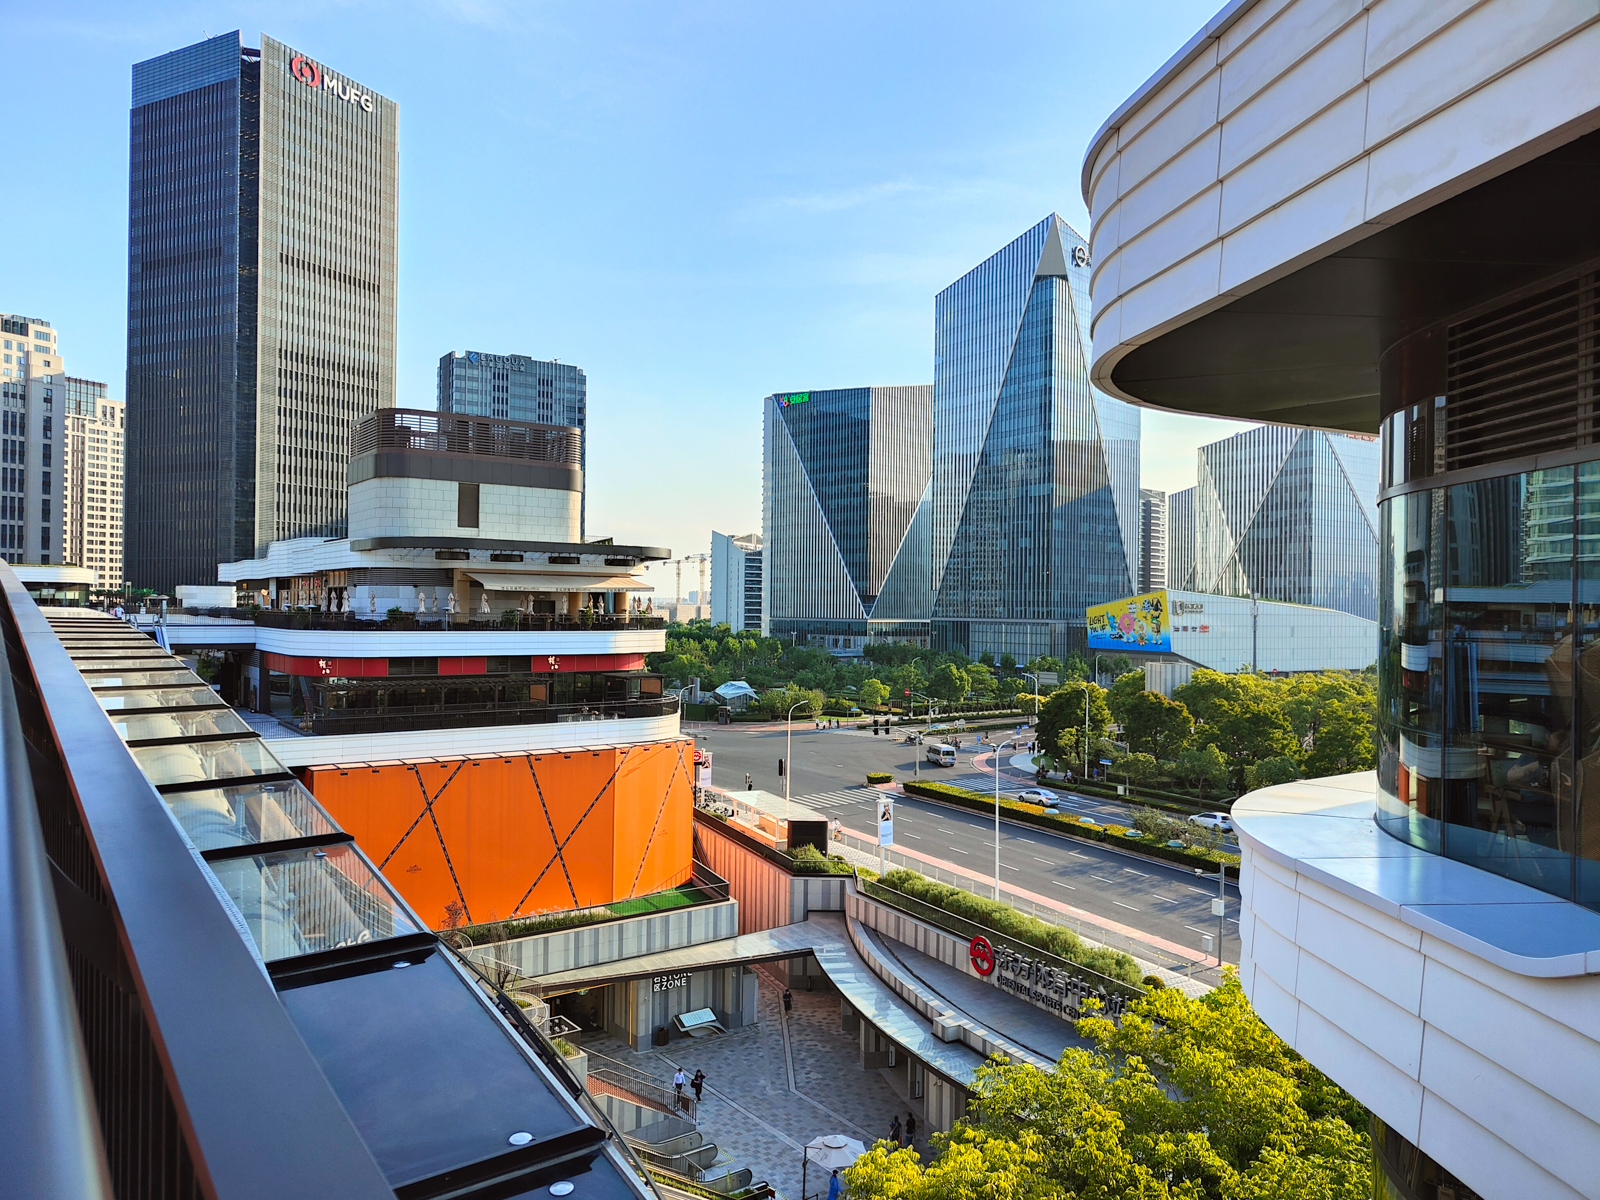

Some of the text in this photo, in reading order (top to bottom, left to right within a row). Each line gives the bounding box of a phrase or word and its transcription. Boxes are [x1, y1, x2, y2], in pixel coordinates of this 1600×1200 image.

[323, 73, 373, 112] MUFG
[662, 978, 686, 990] ZONE
[997, 974, 1032, 998] ORIENTAL
[1032, 989, 1063, 1012] SPORTS
